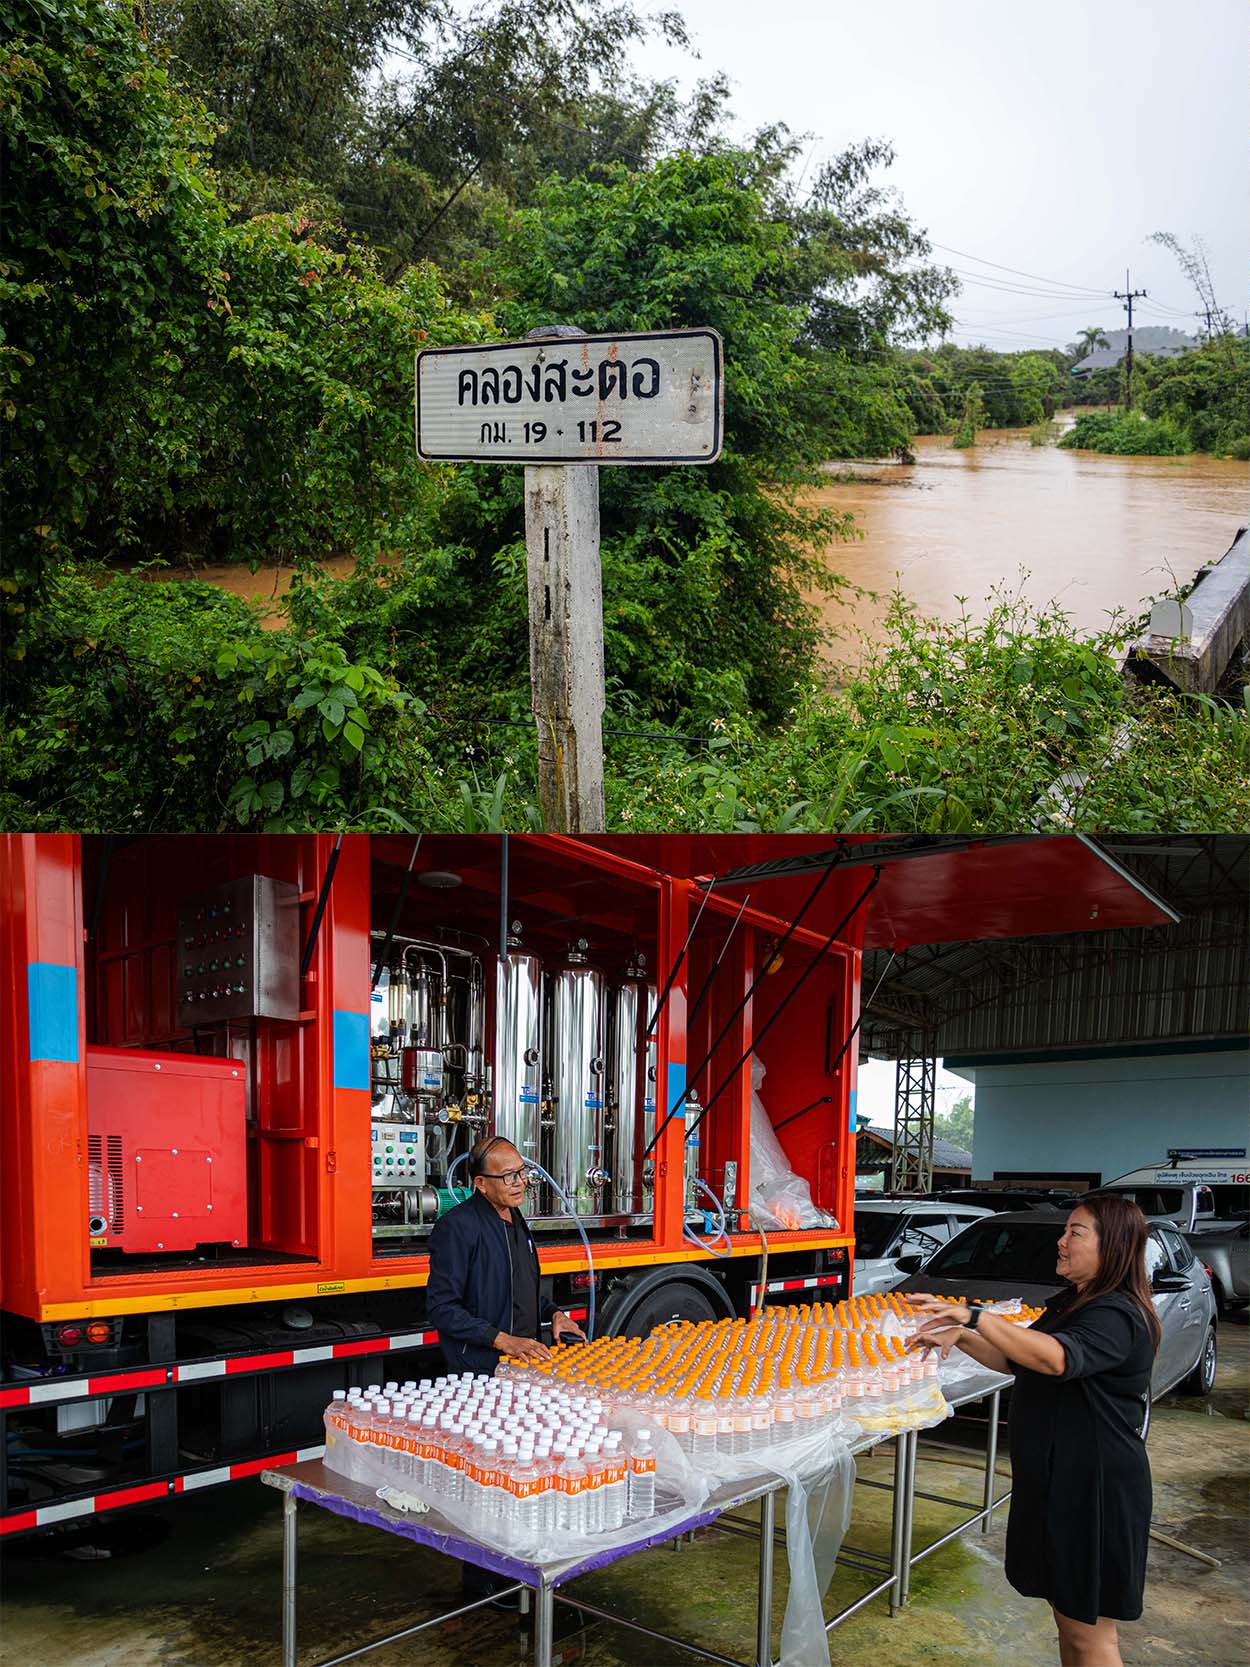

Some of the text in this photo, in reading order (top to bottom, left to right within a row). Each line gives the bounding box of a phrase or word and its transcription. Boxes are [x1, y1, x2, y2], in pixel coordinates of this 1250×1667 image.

[457, 358, 662, 407] คลองสะตอ
[480, 421, 512, 443] กม.
[523, 421, 547, 444] 19
[576, 419, 622, 443] 112
